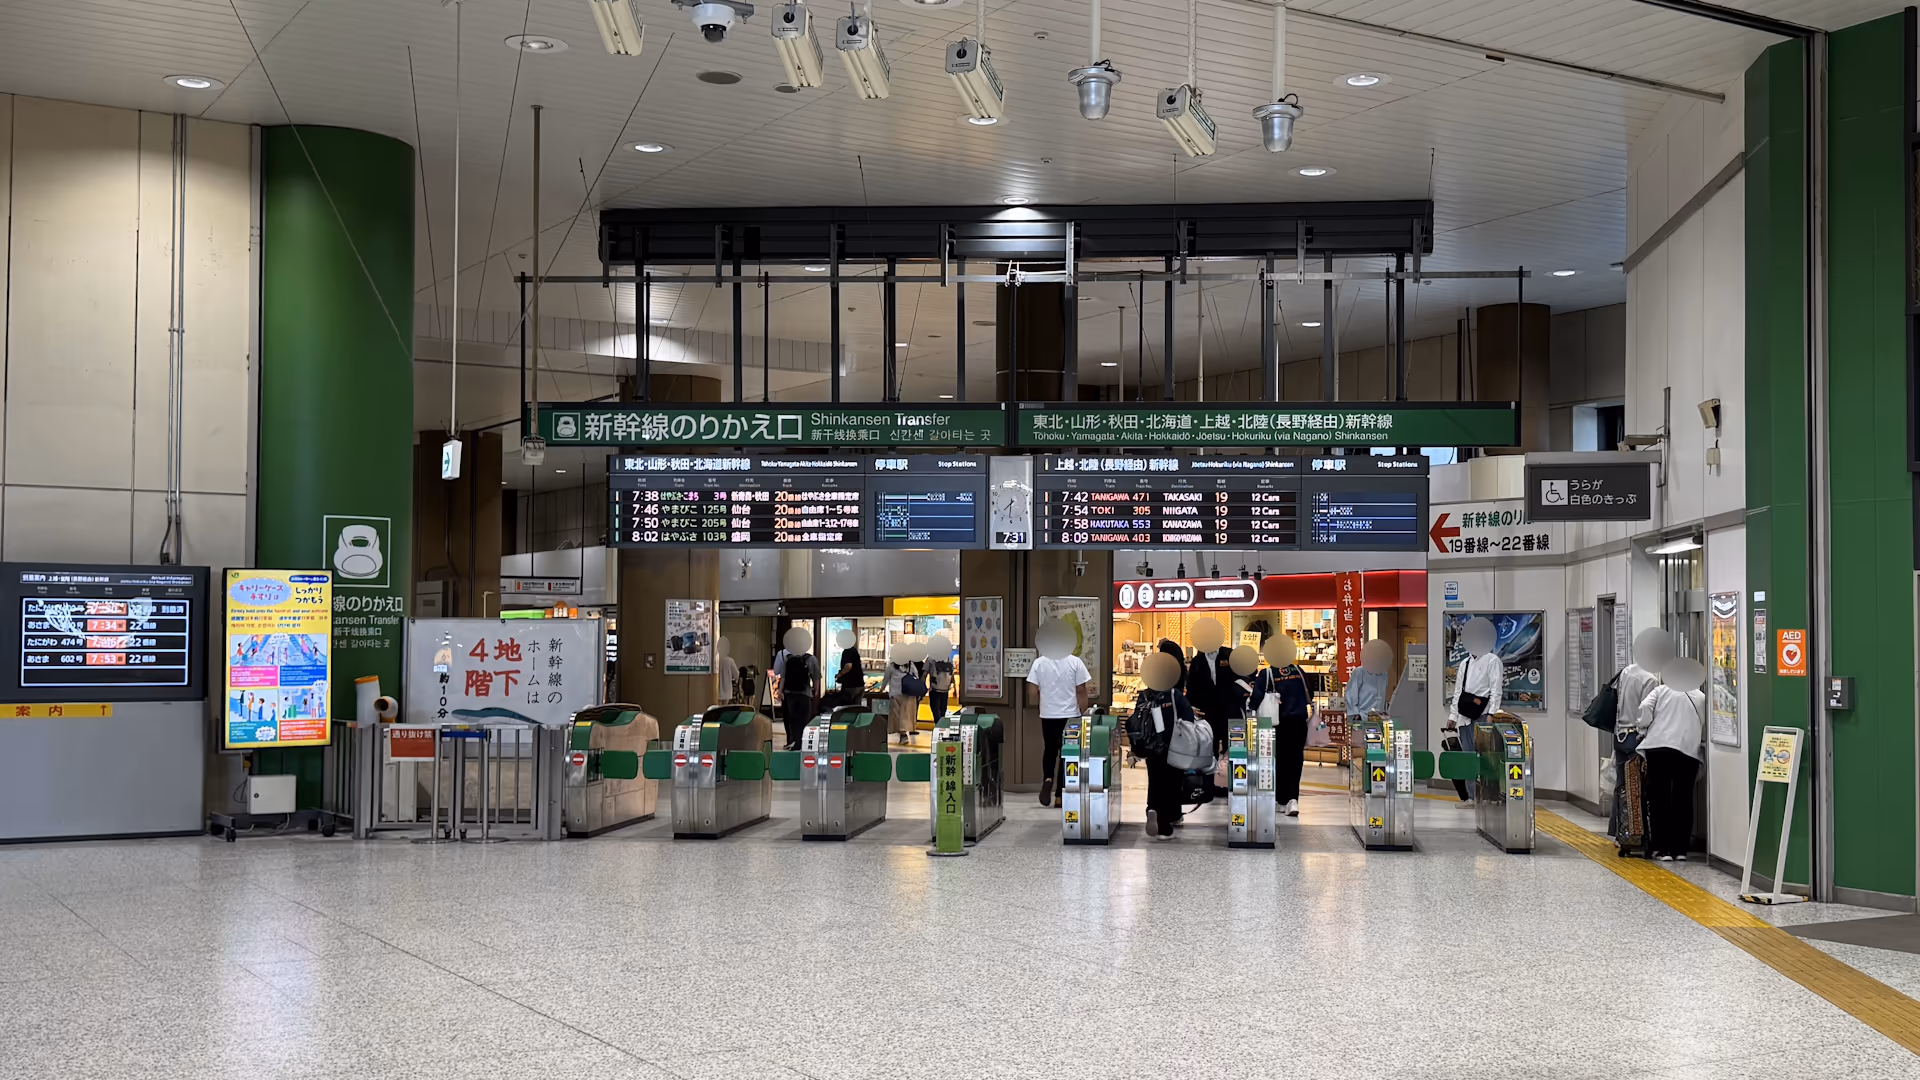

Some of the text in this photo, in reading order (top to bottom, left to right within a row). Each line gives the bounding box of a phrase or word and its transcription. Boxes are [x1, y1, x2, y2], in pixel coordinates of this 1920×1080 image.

[811, 413, 951, 426] Shinkansen Transfer
[585, 413, 802, 441] 新幹線のりかえ口
[811, 429, 880, 441] 新干线换乘口
[890, 429, 991, 441] 신칸센 갈아타는 곳
[1121, 432, 1143, 440] Akita
[1232, 432, 1271, 440] Hokuriku
[1274, 432, 1290, 442] (via
[1293, 432, 1331, 442] Nagano)
[1335, 432, 1387, 440] Shinkansen
[875, 459, 908, 470] 停車駅
[1312, 459, 1346, 471] 停車駅
[1570, 479, 1603, 491] うらが
[633, 491, 659, 501] 7:38
[713, 491, 727, 501] 3号
[1062, 491, 1280, 503] 7:42 TANIGAWA 471 TAKASAKI 19 12 Cars
[1570, 494, 1637, 505] 白色のきっぷ
[633, 504, 659, 515] 7:46
[661, 505, 698, 514] やまびこ
[702, 505, 727, 514] 125号
[731, 504, 751, 515] 仙台
[1062, 505, 1280, 516] 7:54 TOKI 305 NIIGATA 19 12 Cars
[633, 517, 659, 528] 7:50
[661, 518, 698, 528] やまびこ
[701, 519, 727, 528] 205号
[731, 517, 751, 528] 仙台
[1062, 518, 1280, 530] 7:58 HAKUTAKA 553 KANAZAWA 19 12 Cars
[632, 531, 659, 542] 8:02
[661, 532, 697, 542] はやぶさ
[703, 532, 727, 541] 103号
[1002, 532, 1025, 543] 7:31
[1061, 532, 1280, 544] 8:09 TANIGAWA 403 19 12 Cars
[239, 584, 284, 592] キャリーケース
[295, 596, 324, 604] つかもう
[27, 621, 50, 630] あさま
[333, 615, 400, 625] ansen Transfer
[1782, 631, 1802, 640] AED
[27, 638, 58, 647] たにがわ
[61, 638, 84, 647] 474号
[351, 639, 382, 648] 갈아타는
[27, 655, 50, 664] あさま
[60, 655, 83, 664] 602号
[464, 638, 494, 697] 4階
[493, 637, 523, 697] 地下
[527, 639, 541, 705] ホームは
[547, 638, 564, 705] 新幹線の
[16, 705, 63, 717] 案内
[945, 754, 956, 814] 新幹線入口
